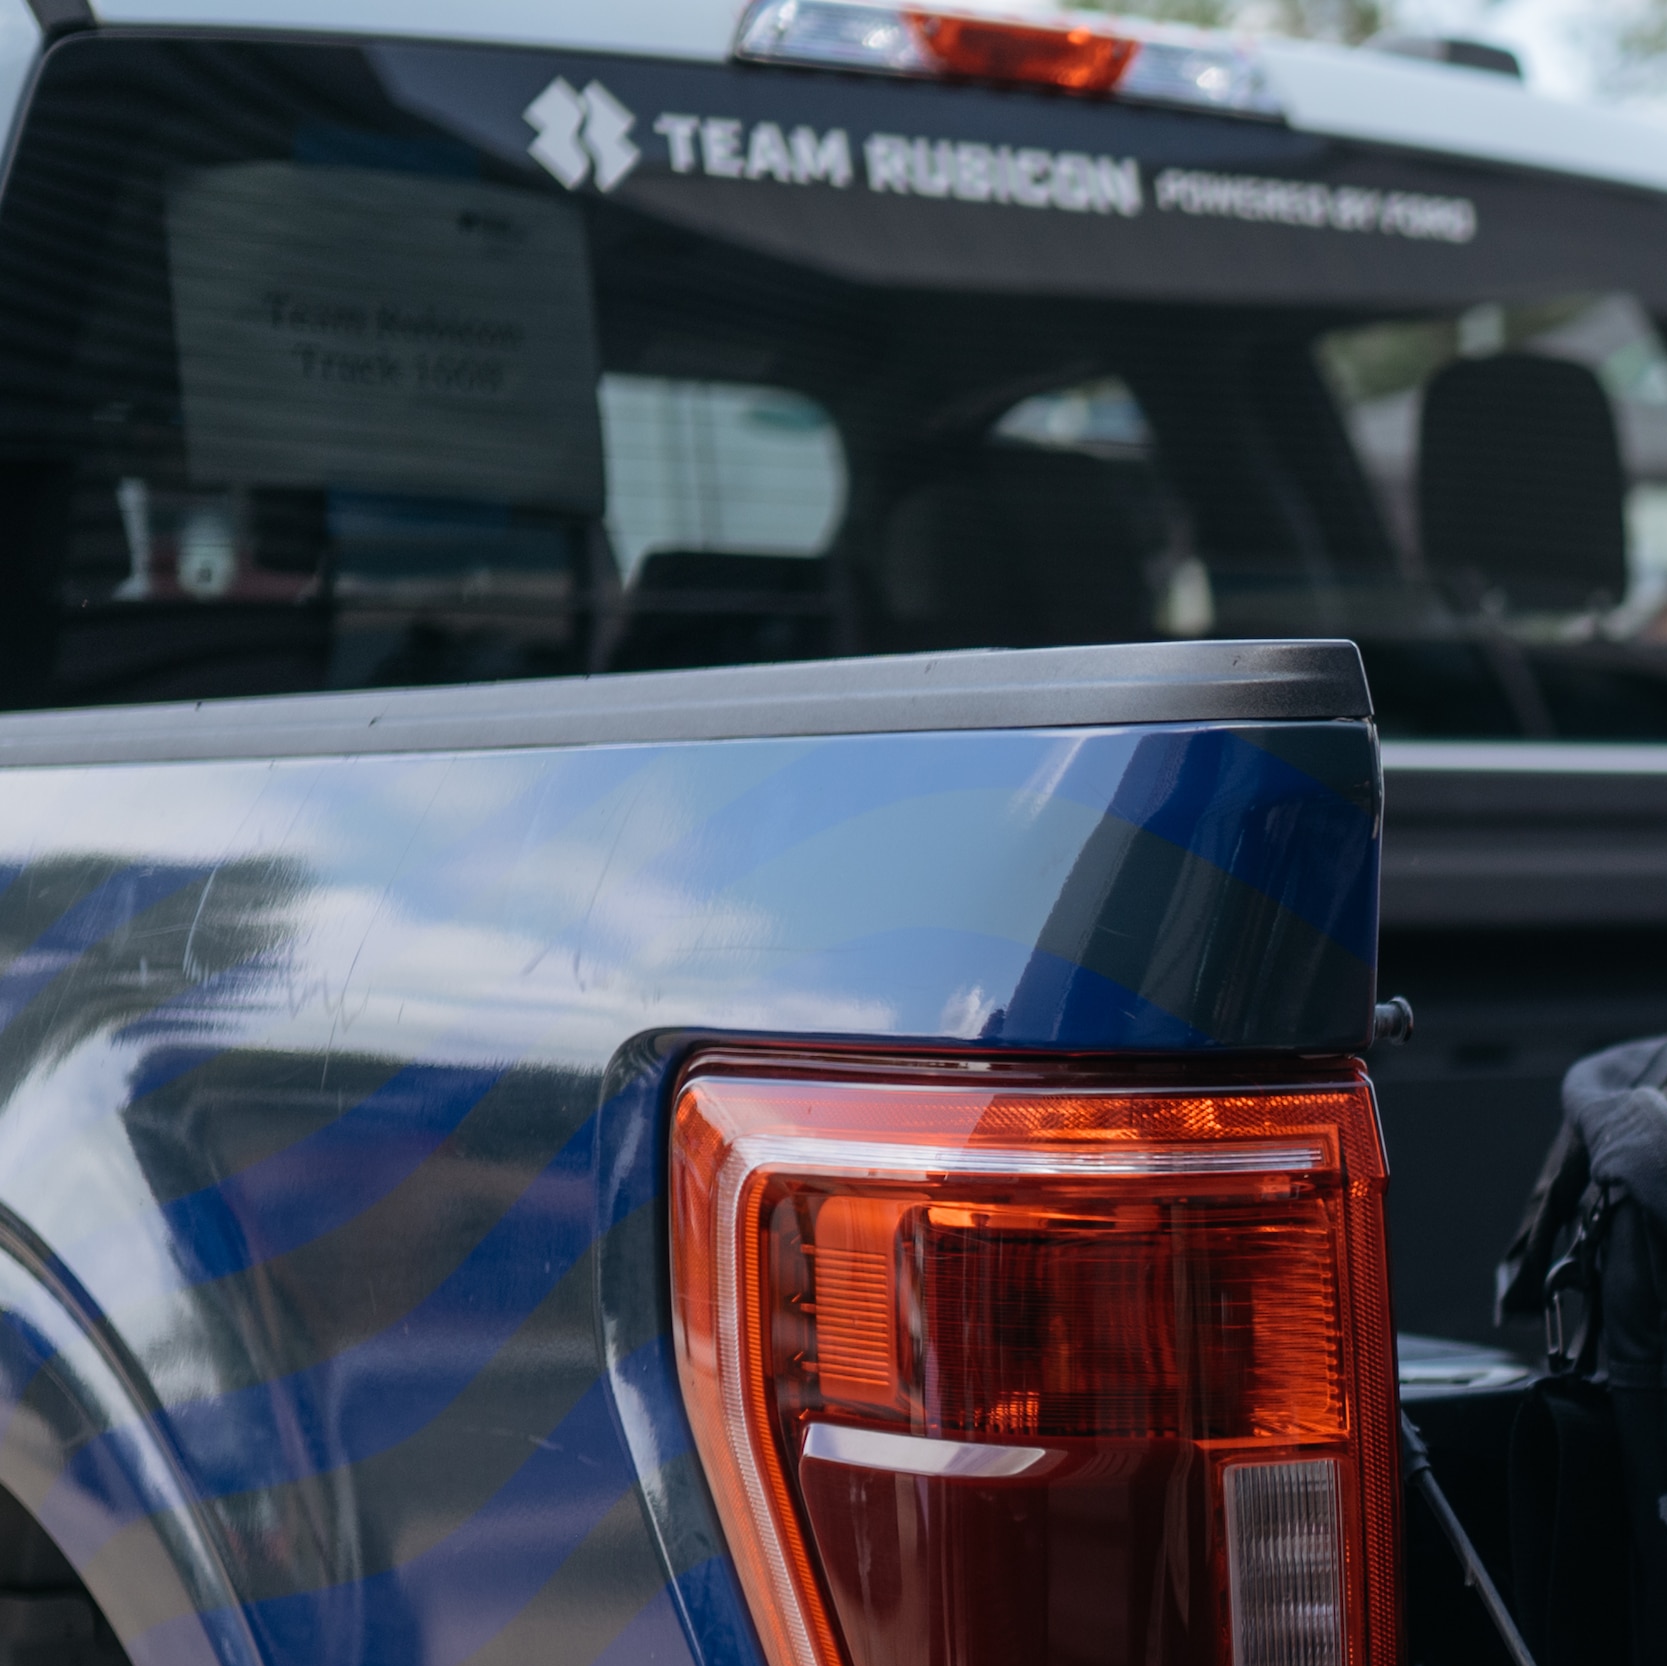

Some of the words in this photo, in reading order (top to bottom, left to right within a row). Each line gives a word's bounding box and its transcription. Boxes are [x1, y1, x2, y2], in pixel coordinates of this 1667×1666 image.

[654, 112, 853, 188] TEAM
[864, 131, 1143, 217] RUBICON
[1154, 168, 1329, 228] POWERED
[1330, 186, 1381, 233] BY
